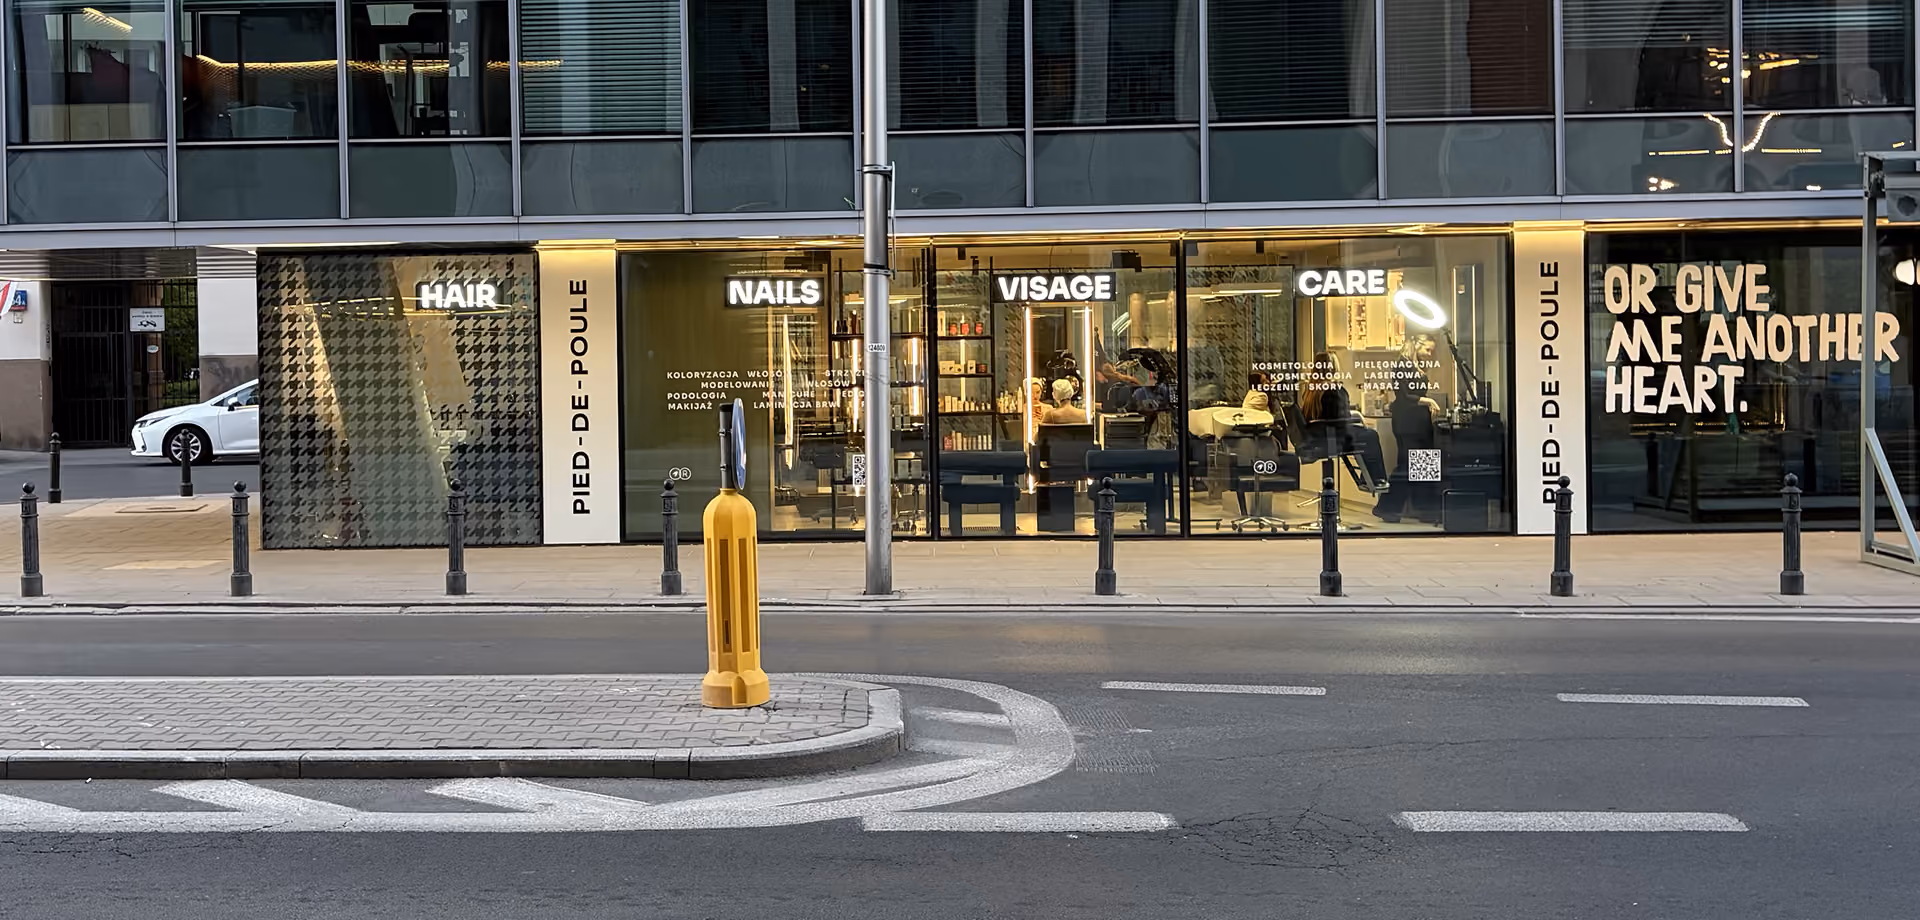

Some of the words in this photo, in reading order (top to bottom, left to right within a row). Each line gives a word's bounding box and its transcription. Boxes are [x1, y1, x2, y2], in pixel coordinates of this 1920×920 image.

[729, 279, 820, 304] NAILS
[998, 275, 1111, 300] VISAGE
[1299, 269, 1385, 296] CARE
[1604, 264, 1656, 314] OR
[1675, 263, 1770, 313] GIVE
[420, 284, 497, 309] HAIR
[1606, 315, 1683, 363] ME
[1701, 311, 1900, 362] ANOTHER
[666, 370, 739, 379] KOLORYZACJA
[1252, 362, 1334, 370] KOSMETOLOGIA
[1354, 360, 1441, 370] PIELĘGNACYJNA
[1270, 372, 1352, 380] KOSMETOLOGIA
[1364, 371, 1421, 379] LASEROWA
[569, 279, 590, 514] PIED-DE-POULE
[667, 391, 727, 400] PODOLOGIA
[1251, 383, 1300, 391] LECZENIE
[1308, 382, 1343, 391] SKÓRY
[1363, 380, 1400, 390] MASAŻ
[1408, 381, 1440, 390] CIAŁA
[1605, 364, 1748, 414] HEART.
[667, 400, 713, 410] MAKIJAŻ
[753, 401, 812, 409] LAMINCJA
